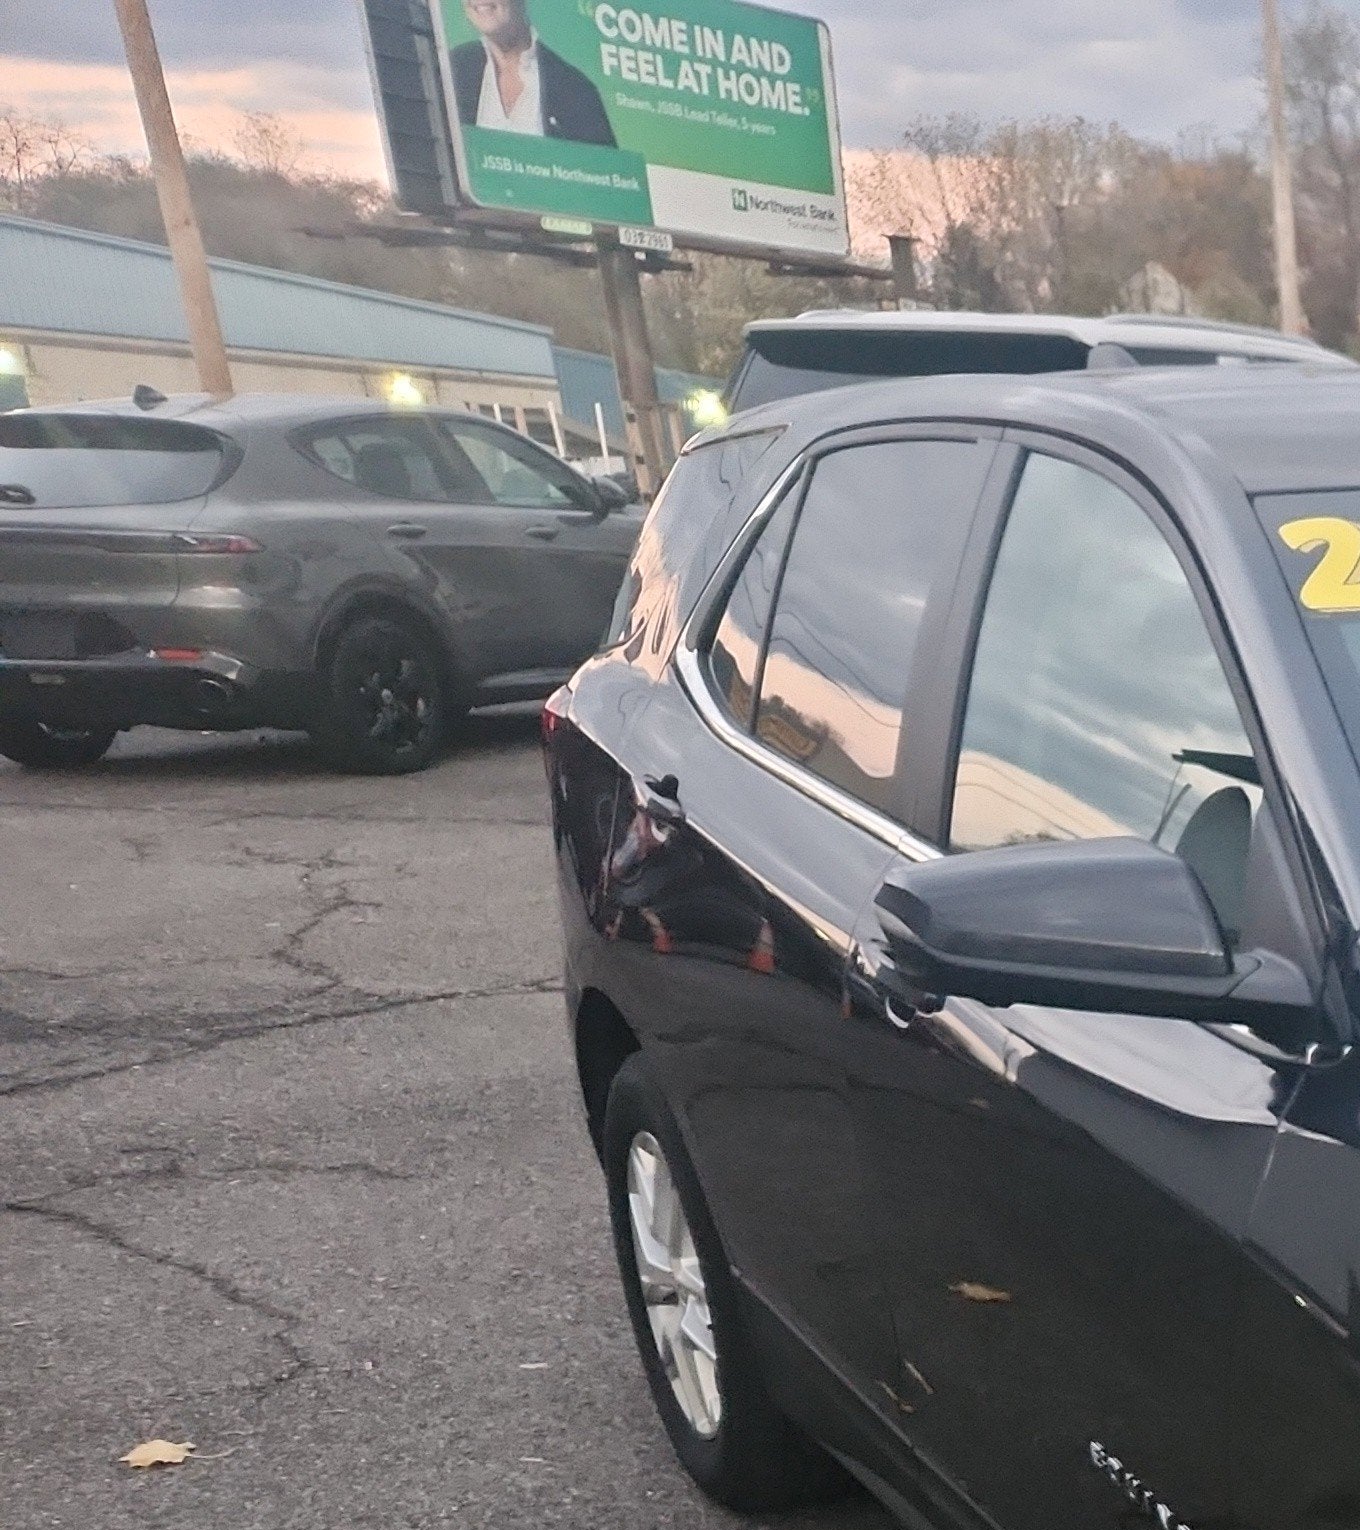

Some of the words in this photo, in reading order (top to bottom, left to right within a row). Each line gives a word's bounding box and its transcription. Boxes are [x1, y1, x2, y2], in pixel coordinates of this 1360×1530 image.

[600, 43, 674, 89] FEEL
[677, 59, 712, 96] AT
[693, 24, 726, 64] IN
[730, 34, 792, 76] AND
[483, 154, 512, 172] JSSB
[514, 159, 524, 174] is
[525, 165, 551, 178] now
[552, 164, 611, 187] Northwest
[612, 173, 640, 192] Bank
[749, 194, 808, 218] Northwest
[809, 203, 838, 222] Bank
